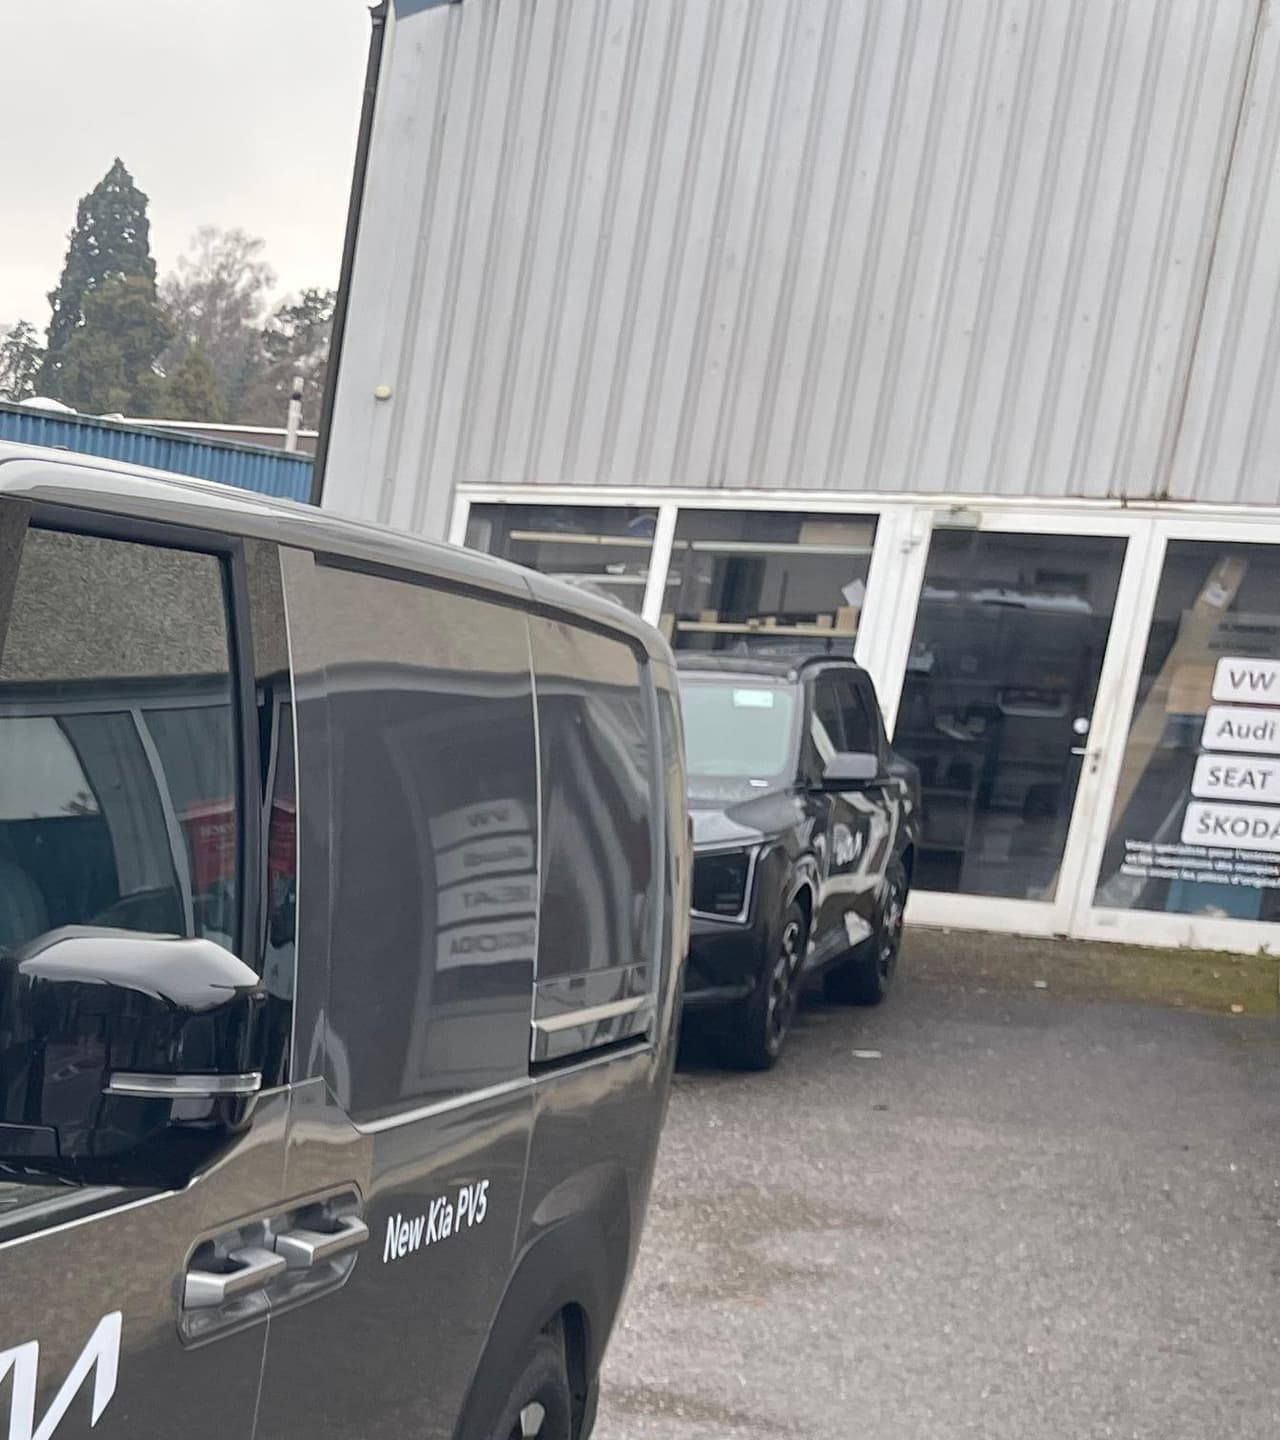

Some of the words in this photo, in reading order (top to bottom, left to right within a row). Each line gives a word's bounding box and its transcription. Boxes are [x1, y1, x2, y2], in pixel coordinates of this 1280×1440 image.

[1229, 669, 1276, 691] VW
[1217, 720, 1276, 741] Audi
[1207, 766, 1273, 790] SEAT
[383, 1213, 426, 1264] New
[425, 1195, 454, 1246] Kia
[455, 1179, 490, 1233] PV5
